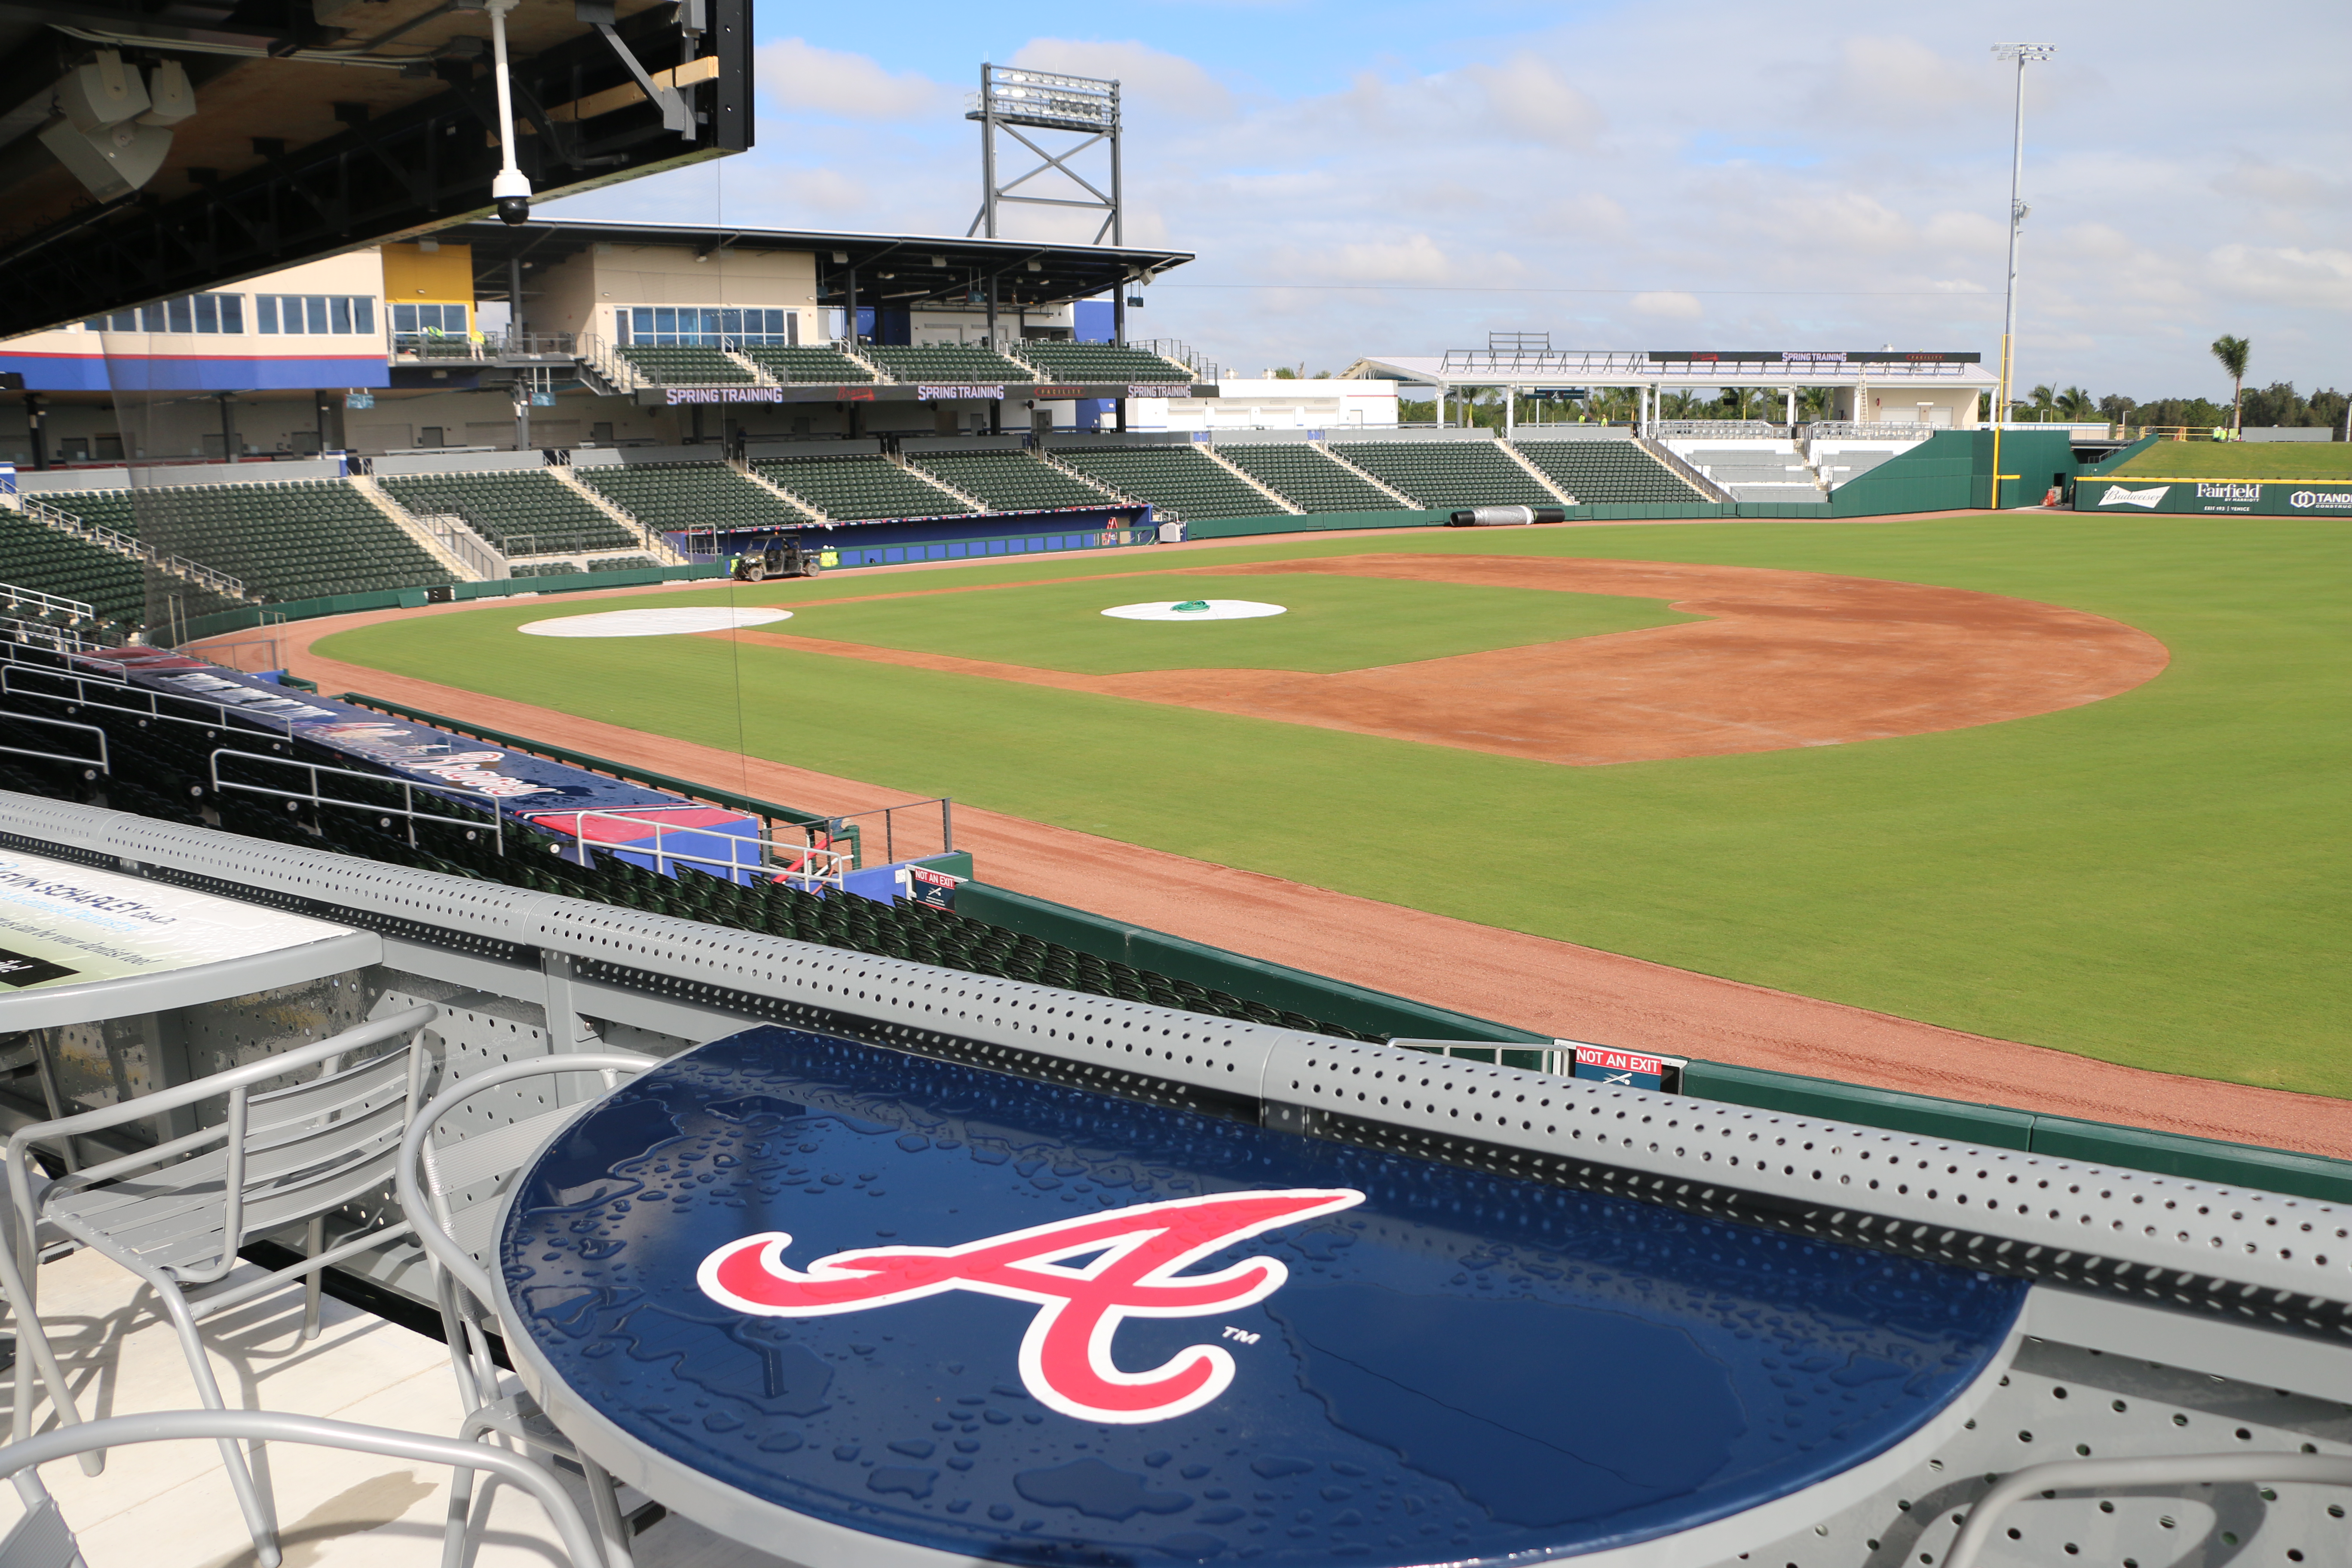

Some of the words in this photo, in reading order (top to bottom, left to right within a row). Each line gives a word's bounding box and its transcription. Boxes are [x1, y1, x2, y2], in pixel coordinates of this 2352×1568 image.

[1782, 352, 1811, 361] SPRING
[1812, 352, 1847, 361] TRAINING
[666, 388, 720, 405] SPRING
[720, 387, 783, 403] TRAINING
[918, 385, 957, 401] SPRING
[958, 385, 1004, 400] TRAINING
[1128, 385, 1156, 398] SPRING
[1157, 385, 1191, 398] TRAINING
[2104, 489, 2162, 500] Budweiser
[2317, 493, 2352, 503] TAND
[377, 751, 557, 797] Braves
[0, 870, 52, 889] EVIN
[916, 869, 928, 881] NOT
[929, 873, 938, 884] AN
[940, 876, 954, 888] EXIT
[13, 897, 80, 914] General
[64, 910, 144, 932] Dentistry
[9, 925, 42, 933] can
[31, 928, 58, 937] be
[37, 935, 87, 945] your
[75, 942, 135, 958] dentist
[118, 955, 164, 966] too!
[1576, 1048, 1604, 1064] NOT
[1606, 1054, 1626, 1068] AN
[1630, 1057, 1658, 1072] EXIT
[1222, 1325, 1261, 1344] TM
